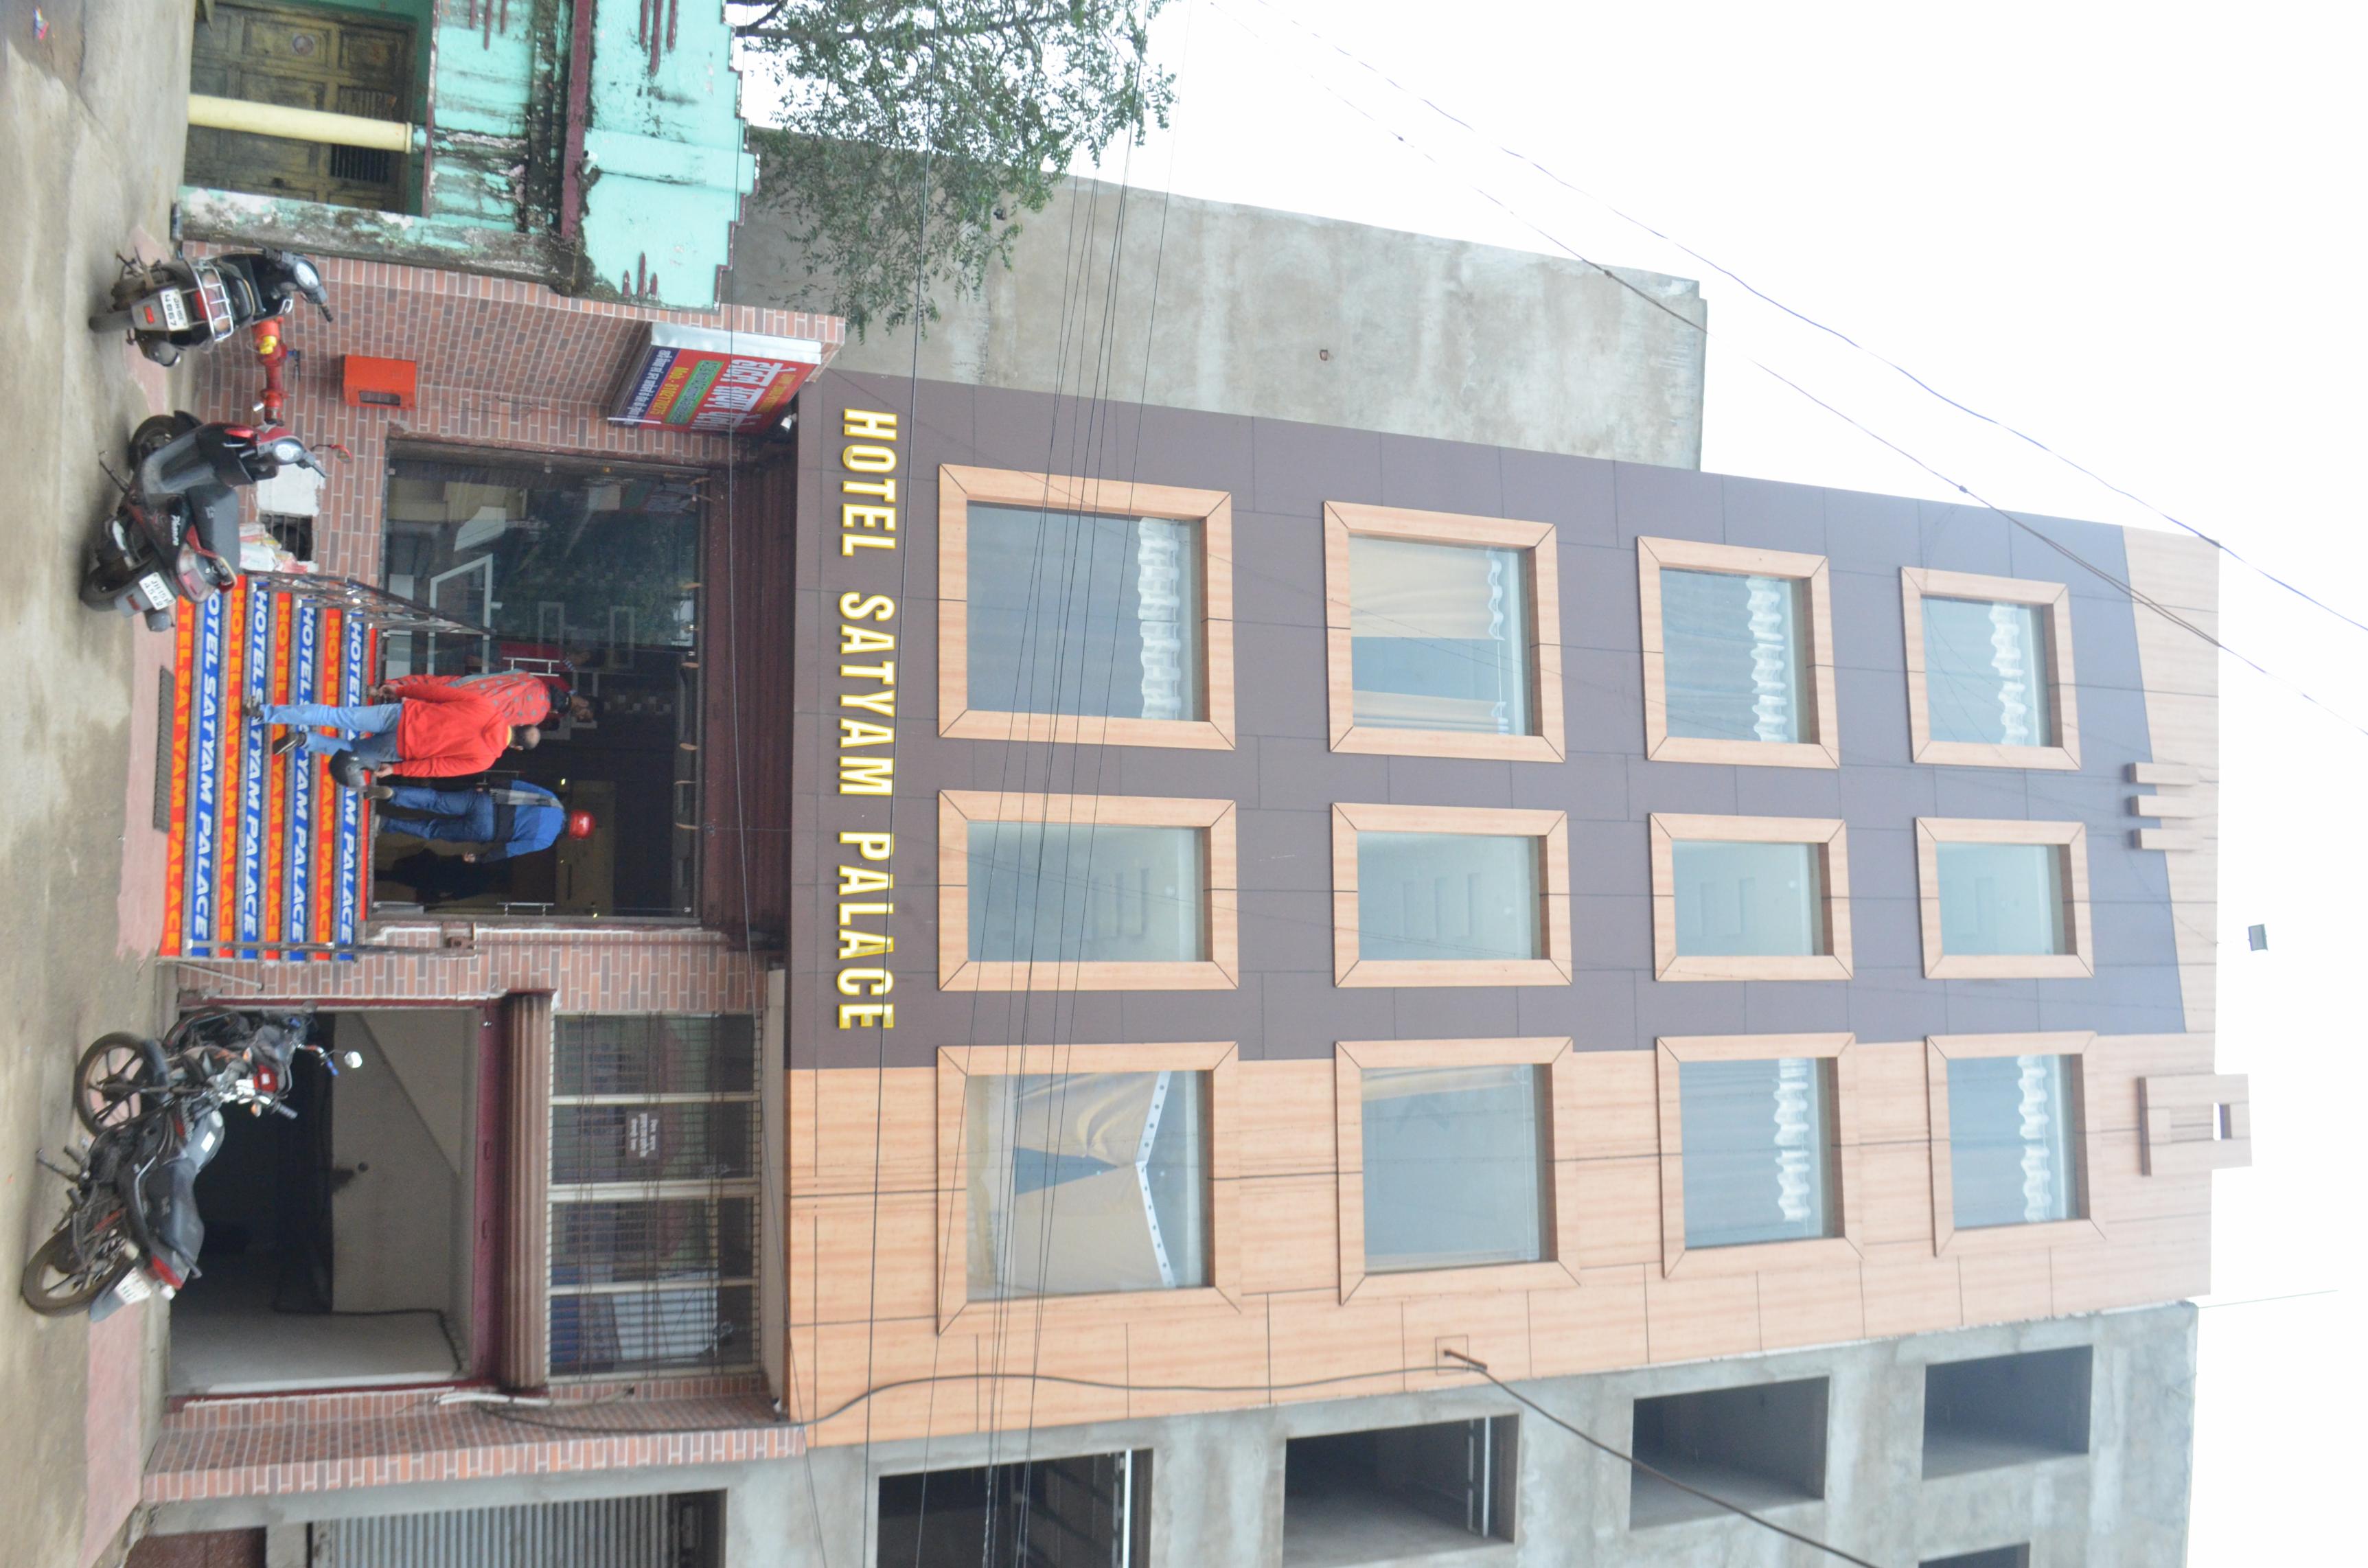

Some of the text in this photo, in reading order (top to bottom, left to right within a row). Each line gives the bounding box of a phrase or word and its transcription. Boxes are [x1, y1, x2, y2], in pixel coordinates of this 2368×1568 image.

[720, 360, 796, 387] होटल
[252, 590, 267, 683] HOTEL
[275, 601, 288, 697] HOTEL
[299, 607, 314, 695] HOTEL
[325, 618, 339, 706] HOTEL
[347, 623, 362, 707] HOTEL
[172, 670, 191, 808] SATYAM
[195, 588, 220, 940] OTEL SATYAM PALACE
[219, 589, 244, 943] HOTEL SATYAM PALACE
[836, 408, 897, 1030] HOTEL SATYAM PALACE
[166, 821, 185, 949] PALACE
[244, 814, 259, 937] PALACE
[292, 825, 308, 943] PALACE
[319, 842, 333, 943] PALACE
[341, 831, 355, 944] PALACE
